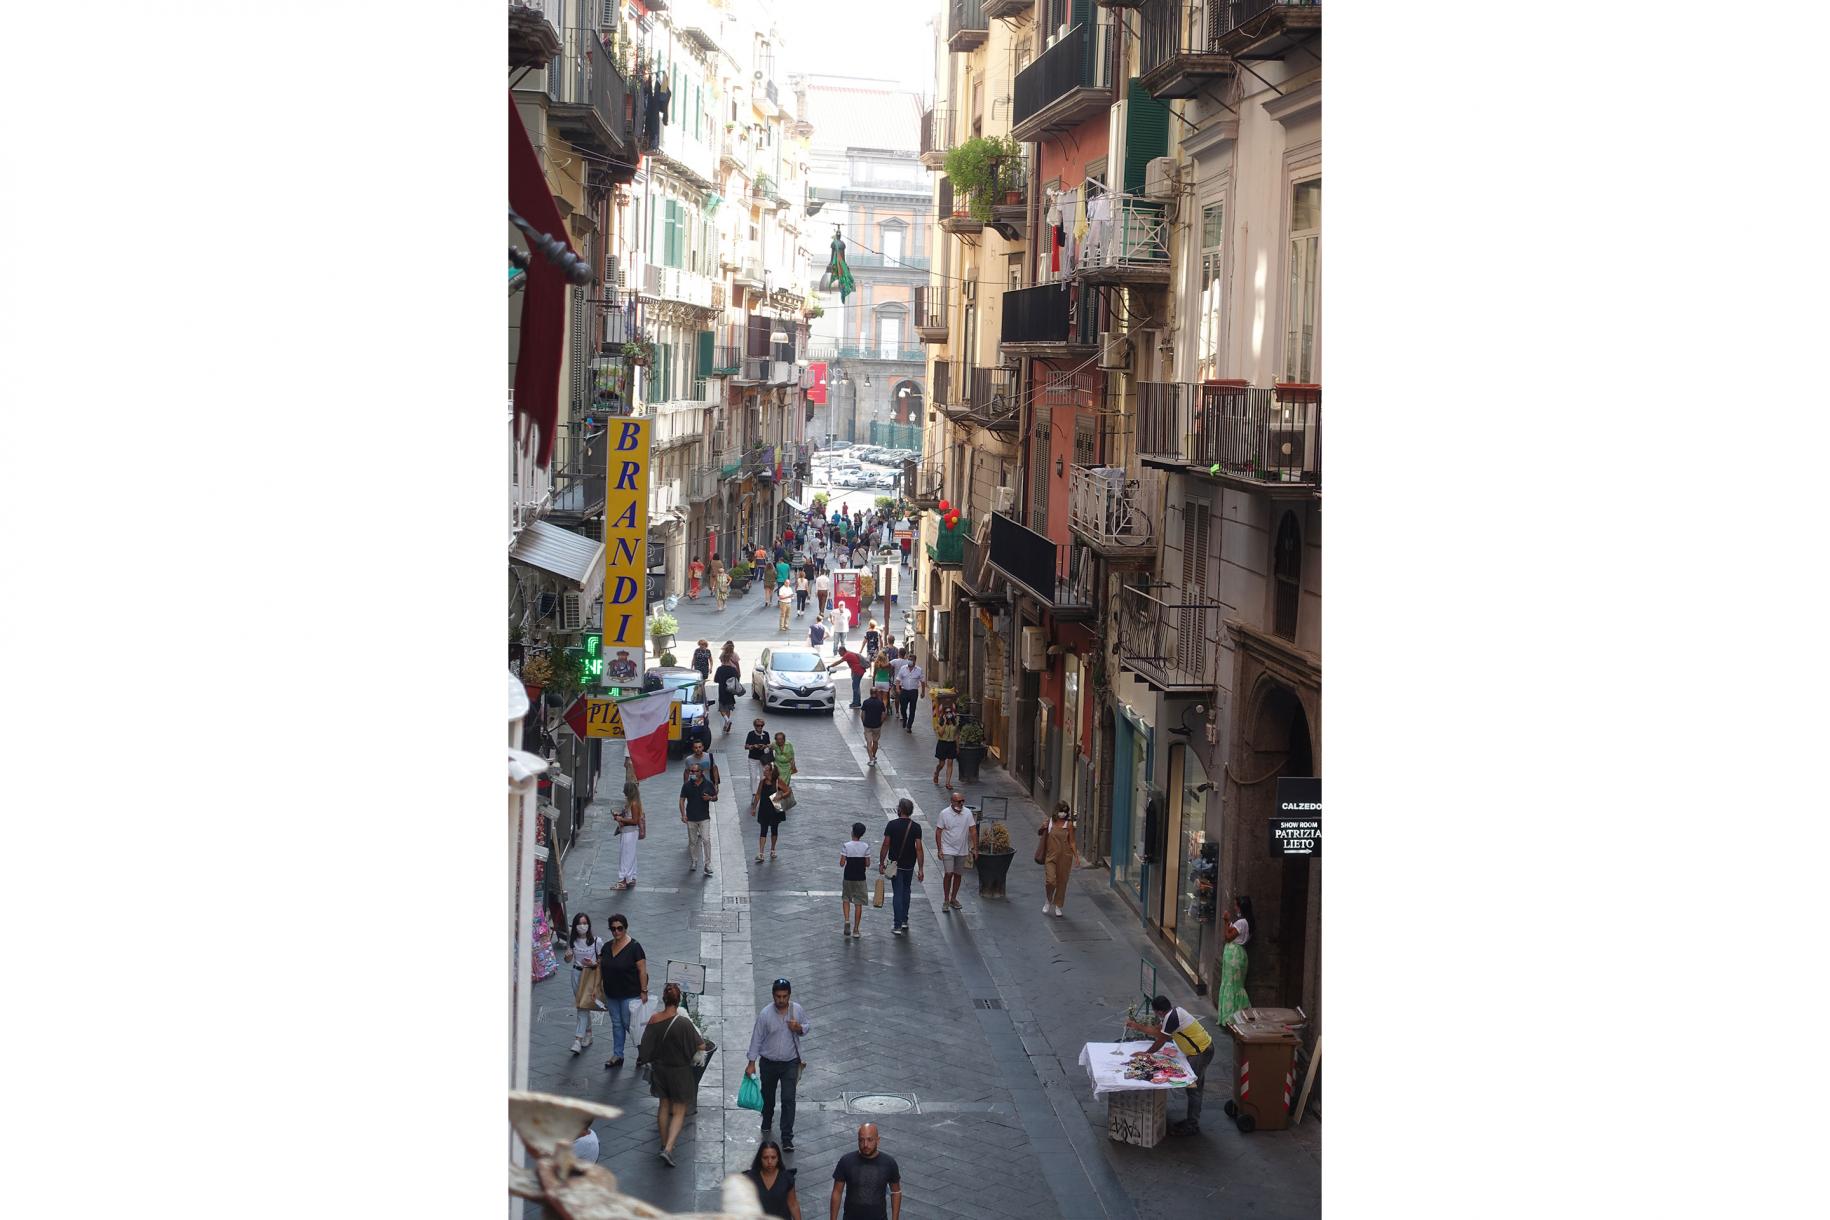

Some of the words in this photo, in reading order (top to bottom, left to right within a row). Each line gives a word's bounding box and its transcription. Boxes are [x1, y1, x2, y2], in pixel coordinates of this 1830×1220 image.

[609, 422, 641, 642] BRANDI
[1282, 802, 1322, 810] CALZEDO
[1275, 829, 1322, 838] PATRIZIA
[1283, 839, 1314, 849] LIETO
